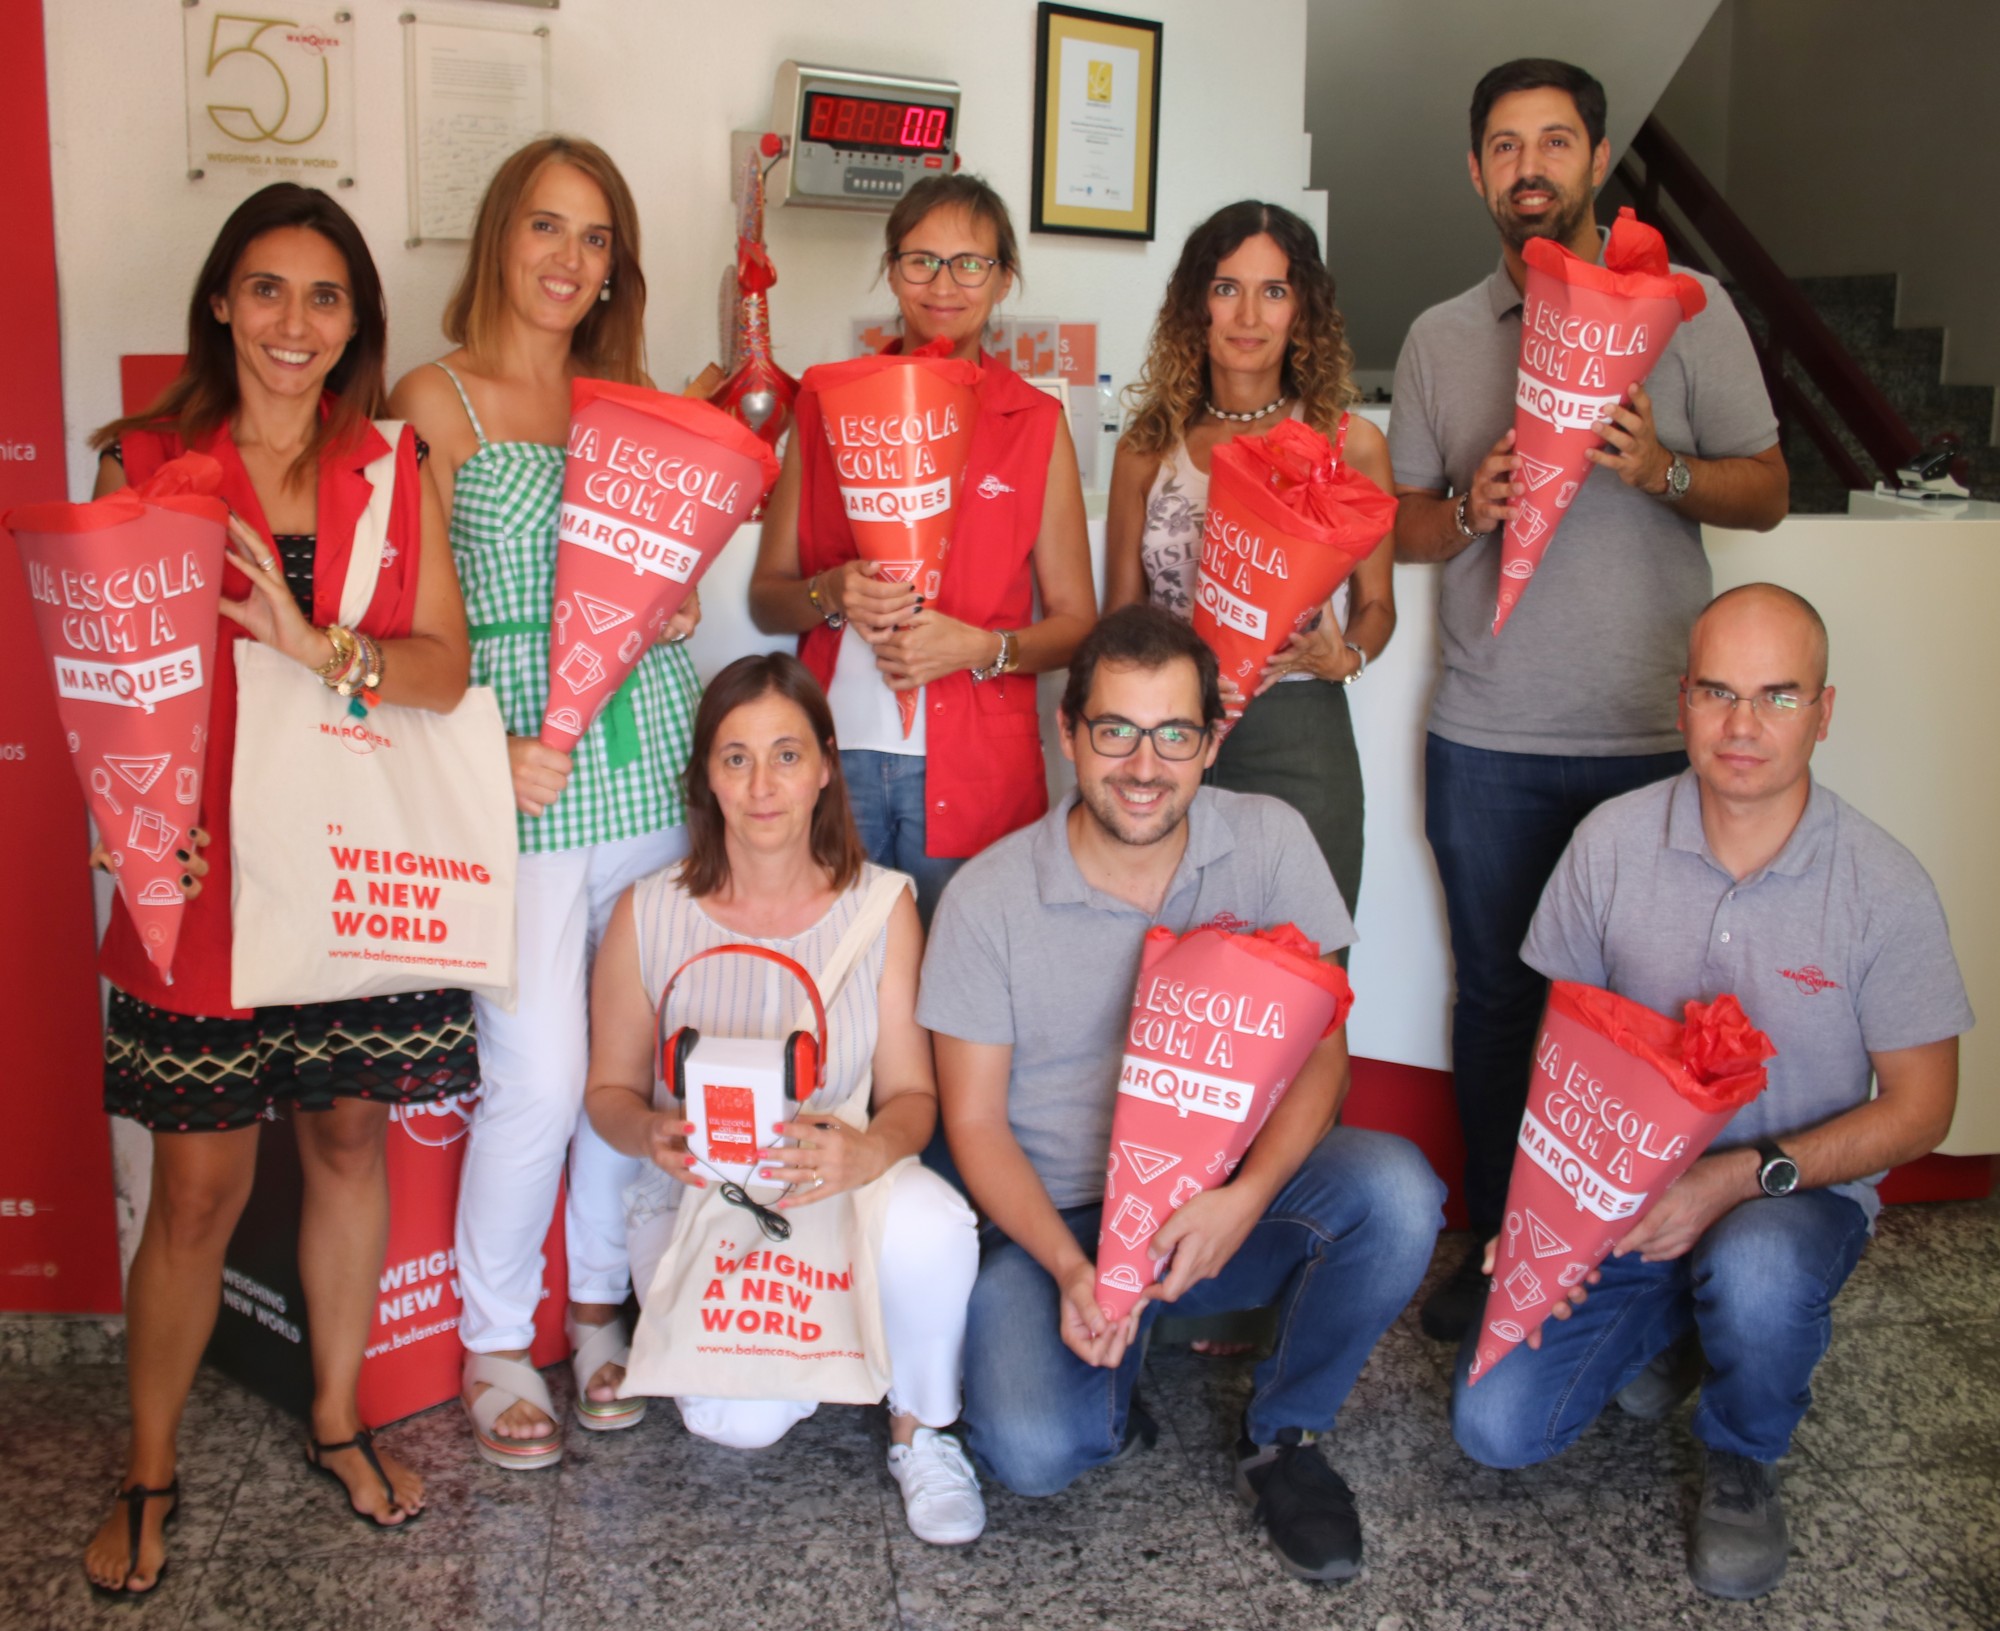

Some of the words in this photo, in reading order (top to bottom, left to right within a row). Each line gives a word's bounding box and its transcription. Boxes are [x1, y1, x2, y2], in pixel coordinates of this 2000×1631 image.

[1534, 301, 1649, 357] ESCOLA
[1523, 335, 1572, 382] COM
[1578, 356, 1606, 388] A
[1518, 380, 1609, 424] ARQUES
[840, 403, 959, 447] ESCOLA
[606, 436, 742, 515] ESCOLA
[837, 448, 903, 480] COM
[914, 444, 937, 477] A
[584, 470, 668, 523] COM
[668, 499, 698, 536] A
[843, 488, 947, 521] ARQUES
[560, 512, 692, 573] MARQUES
[29, 560, 61, 606] NA
[61, 551, 206, 612] ESCOLA
[1232, 562, 1252, 596] A
[62, 611, 139, 654] COM
[150, 604, 177, 647] A
[61, 659, 195, 706] MARQUES
[319, 723, 392, 749] MARQUES
[329, 846, 492, 885] WEIGHING
[332, 878, 356, 903] A
[368, 881, 441, 911] NEW
[331, 911, 449, 944] WORLD
[327, 949, 488, 970] www.balancasmarques.com
[1146, 976, 1286, 1040] ESCOLA
[1130, 1012, 1199, 1060] COM
[1204, 1031, 1234, 1069] A
[1121, 1064, 1243, 1111] ARQUES
[1563, 1061, 1691, 1162] ESCOLA
[1544, 1091, 1610, 1161] COM
[1606, 1146, 1634, 1185] A
[1521, 1120, 1636, 1213] MARQUES
[380, 1283, 443, 1326] NEW
[703, 1278, 726, 1301] A
[741, 1278, 814, 1315] NEW
[255, 1305, 302, 1344] WORLD
[701, 1308, 823, 1343] WORLD
